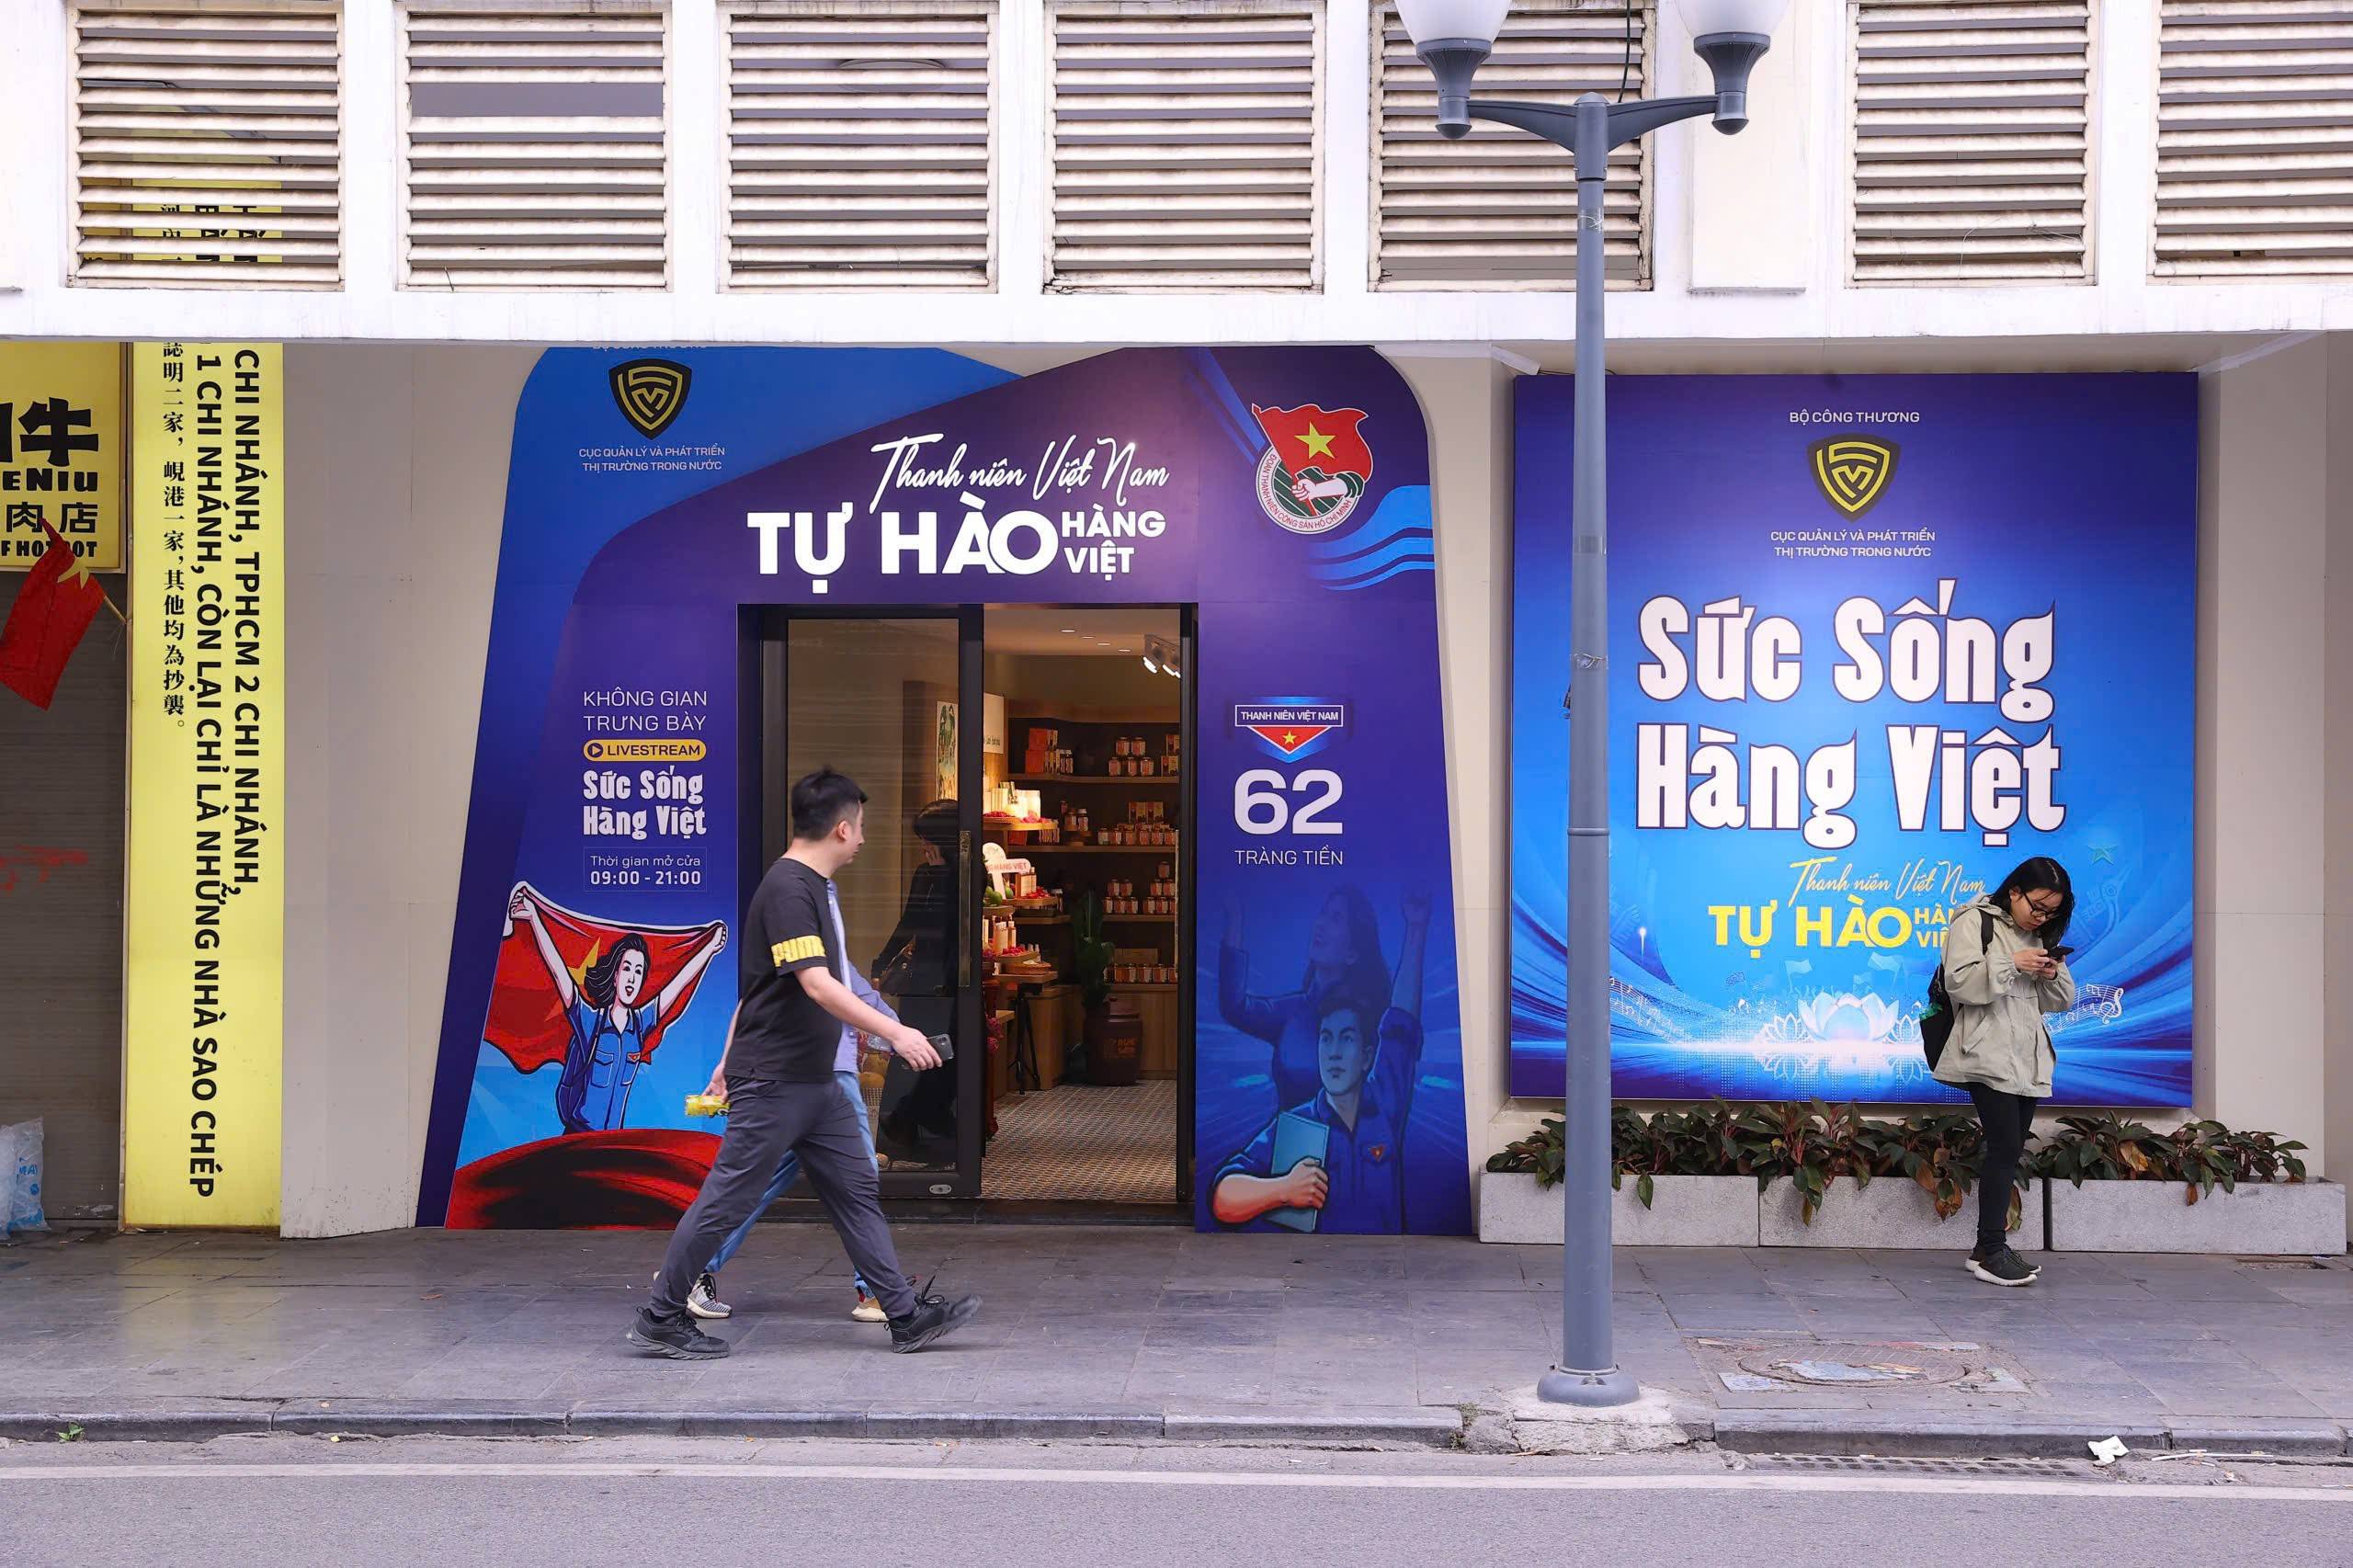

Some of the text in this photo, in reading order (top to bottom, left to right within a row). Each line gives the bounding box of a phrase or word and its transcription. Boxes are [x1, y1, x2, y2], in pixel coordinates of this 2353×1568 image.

[1790, 408, 1920, 426] BỘ CÔNG THƯƠNG
[578, 442, 725, 460] CỤC QUẢN LÝ VÀ PHÁT TRIỂN
[583, 459, 722, 473] THỊ TRƯỜNG TRONG NƯỚC
[869, 433, 1170, 514] Thanh niên Việt Nam
[6, 502, 97, 533] 肉店
[1062, 503, 1166, 538] HÀNG
[17, 540, 97, 557] HOOT
[746, 491, 1059, 594] TỰ HÀO
[1770, 527, 1936, 543] CỤC QUẢN LÝ VÀ PHÁT TRIỂN
[1063, 539, 1135, 581] VIỆT
[1774, 544, 1932, 559] THỊ TRƯỜNG TRONG NƯỚC
[227, 349, 268, 895] CHI NHÁNH, TPHCM 2 CHI NHÁNH,
[1637, 577, 2056, 723] Sức Sống
[583, 687, 708, 707] KHÔNG GIAN
[583, 711, 707, 732] TRƯNG BÀY
[1240, 709, 1339, 722] THANH NIÊN VIỆT NAM
[607, 744, 700, 756] LIVESTREAM
[188, 355, 230, 1198] 1 CHI NHÁNH, CÒN LẠI CHỈ LÀ NHỮNG NHÀ SAO CHÉP
[583, 765, 704, 805] Sức Sống
[1636, 723, 2067, 850] Hàng Việt
[1234, 768, 1344, 835] 62
[583, 805, 707, 840] Hàng Việt
[590, 854, 700, 869] Thời gian mở cửa
[1234, 844, 1344, 866] TRÀNG TIỀN
[590, 870, 640, 885] 09:00
[655, 870, 701, 885] 21:00
[1788, 856, 1985, 907] Thanh niên Việt Nam
[1708, 893, 1913, 959] TỰ HÀO
